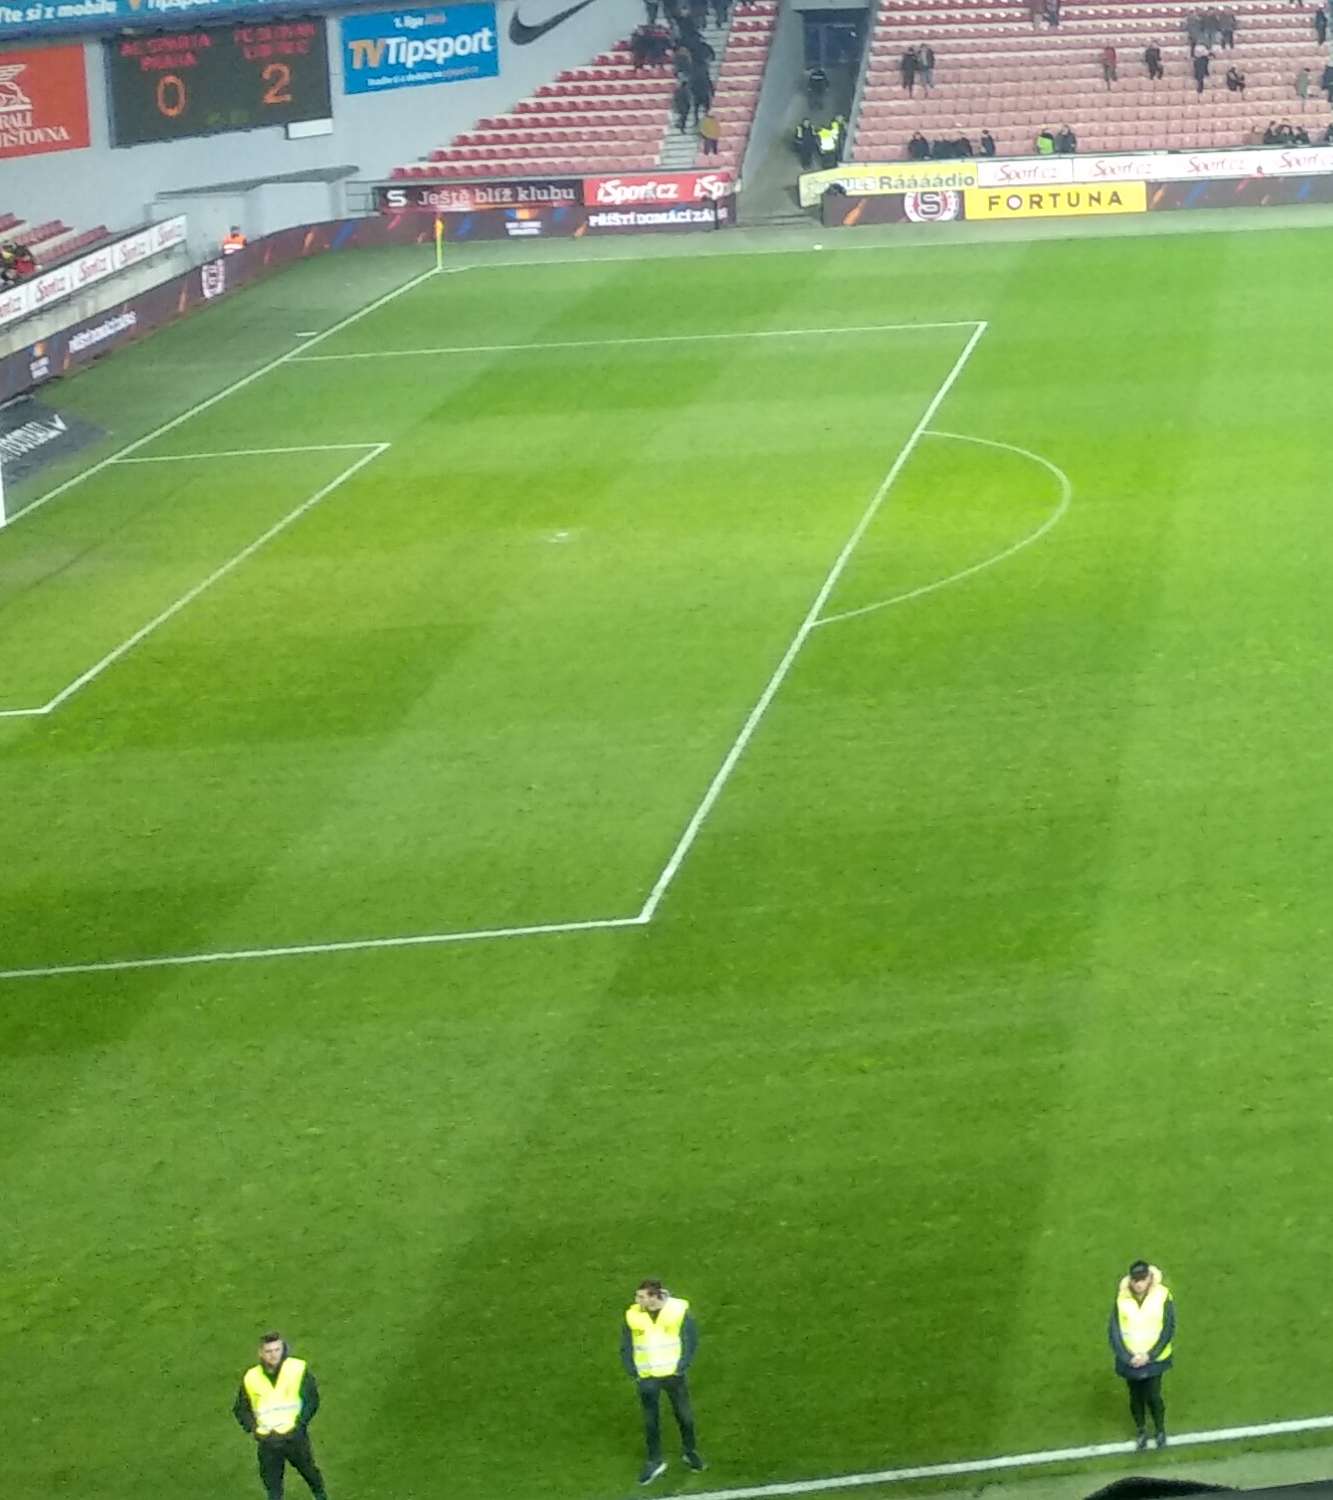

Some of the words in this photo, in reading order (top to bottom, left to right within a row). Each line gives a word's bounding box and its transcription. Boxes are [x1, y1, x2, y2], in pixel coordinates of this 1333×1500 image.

[156, 74, 188, 118] 0
[261, 63, 292, 105] 2
[417, 188, 471, 206] Ještě
[474, 185, 514, 203] blíž
[516, 183, 576, 202] klubu
[988, 190, 1124, 212] FORTUNA
